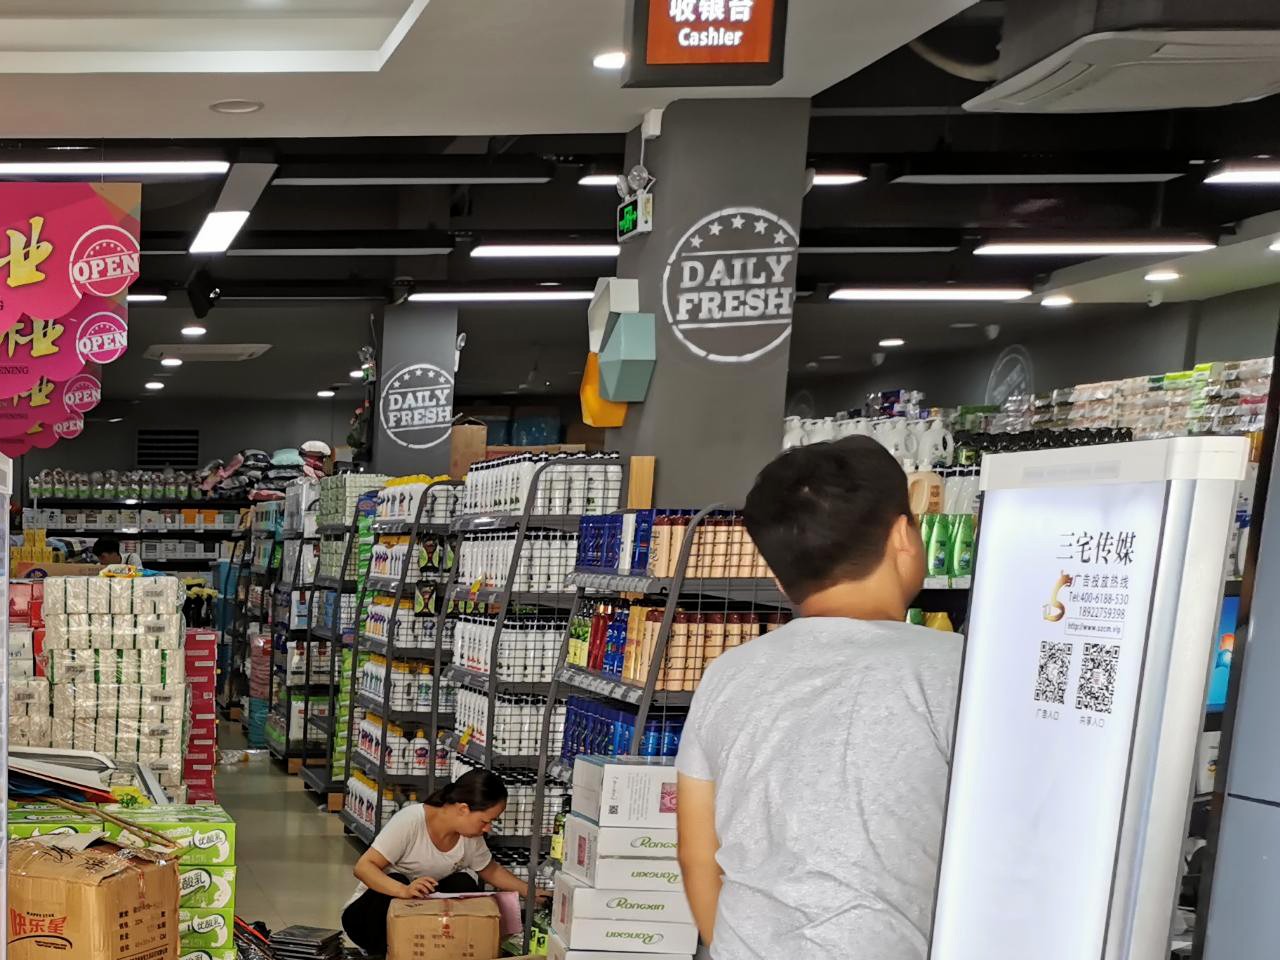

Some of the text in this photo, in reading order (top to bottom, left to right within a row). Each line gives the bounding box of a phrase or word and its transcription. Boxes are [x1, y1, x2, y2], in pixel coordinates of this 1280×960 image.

[677, 27, 744, 47] Cashier
[72, 253, 140, 284] OPEN
[680, 254, 792, 289] DAILY
[676, 287, 792, 321] FRESH
[78, 332, 128, 352] OPEN
[65, 390, 101, 404] OPEN
[388, 389, 450, 410] DAILY
[54, 419, 84, 432] OPEN
[387, 406, 452, 427] FRESH
[1056, 530, 1136, 566] 三宅传媒
[1068, 591, 1129, 605] Tel:400-6188-530
[1078, 606, 1125, 619] 18922759398
[198, 833, 223, 846] 优酸乳
[180, 872, 205, 890] 酸乳
[10, 907, 67, 936] 快乐星
[196, 917, 222, 930] 优酸乳
